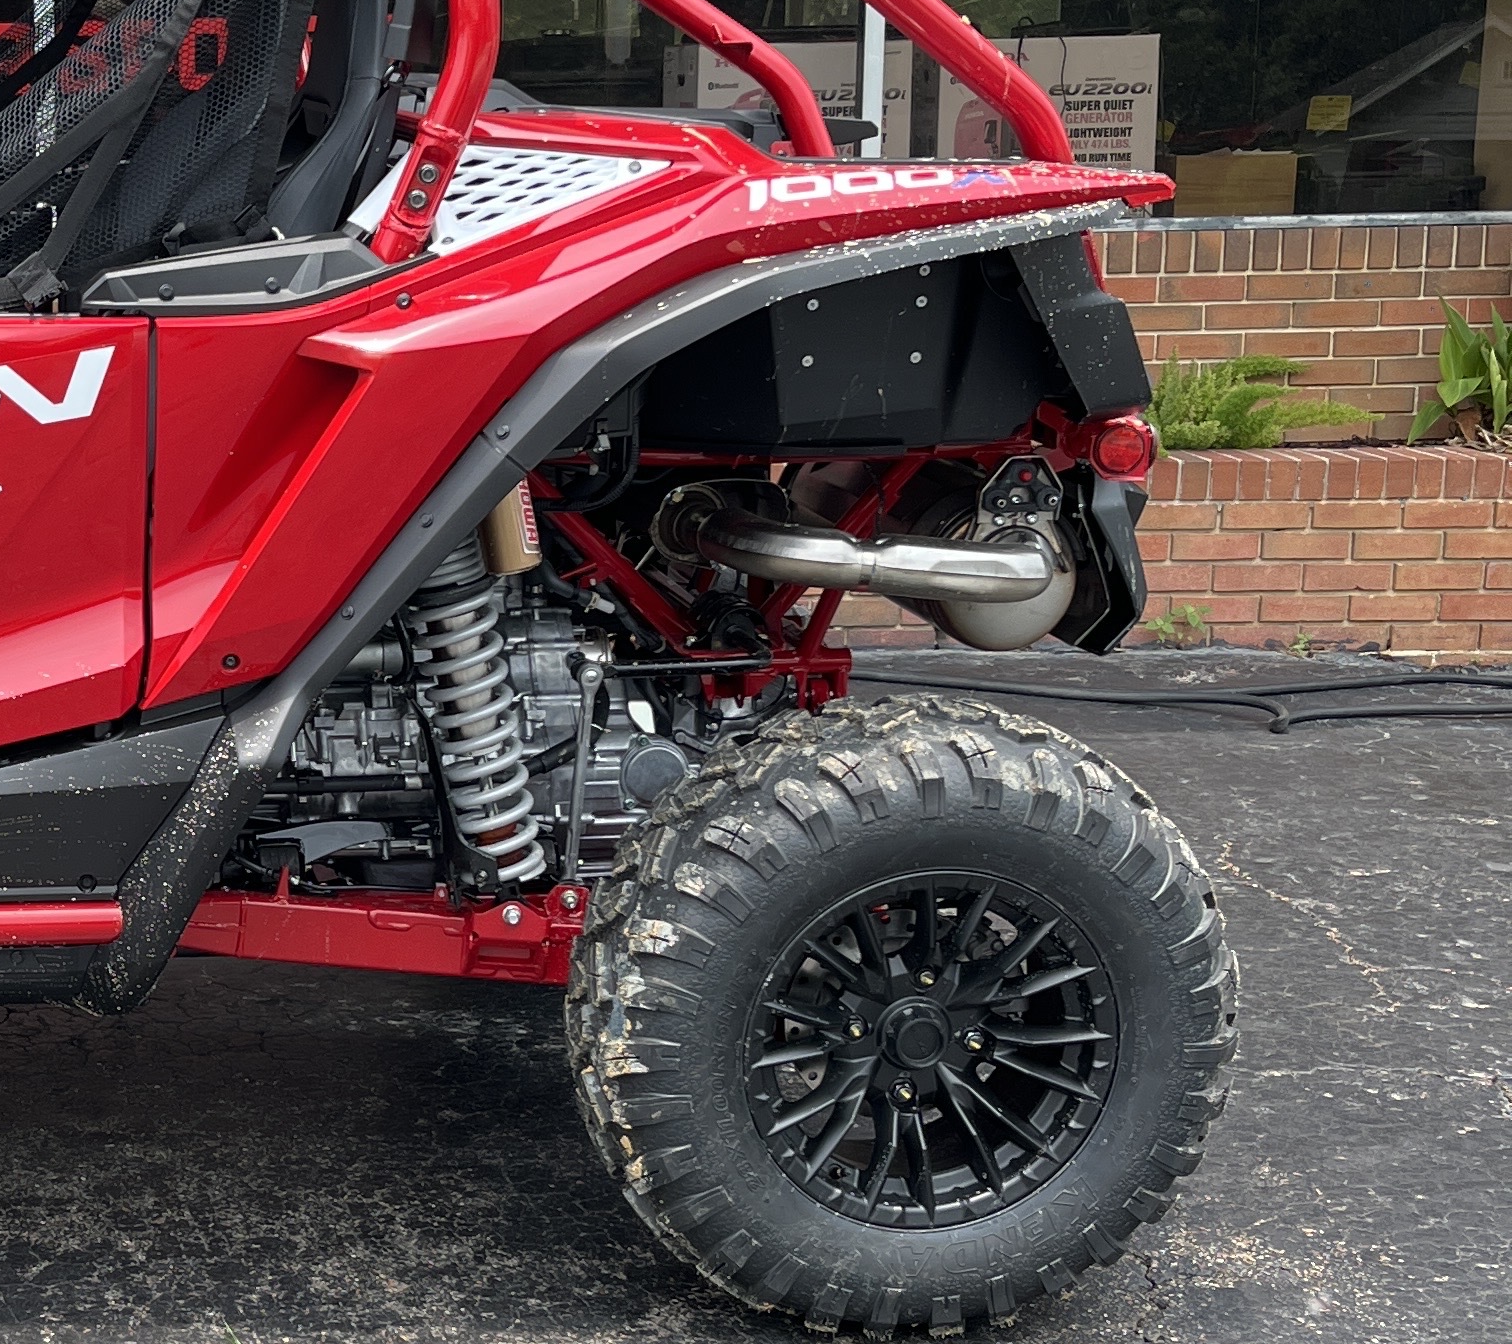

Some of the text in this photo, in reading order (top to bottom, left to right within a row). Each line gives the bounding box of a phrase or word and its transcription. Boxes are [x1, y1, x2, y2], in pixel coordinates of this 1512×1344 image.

[1065, 99, 1134, 112] SUPER QUIET
[1065, 112, 1133, 124] GENERATOR
[1070, 139, 1089, 149] NLY
[1089, 153, 1108, 163] RUN
[1110, 152, 1132, 162] TIME
